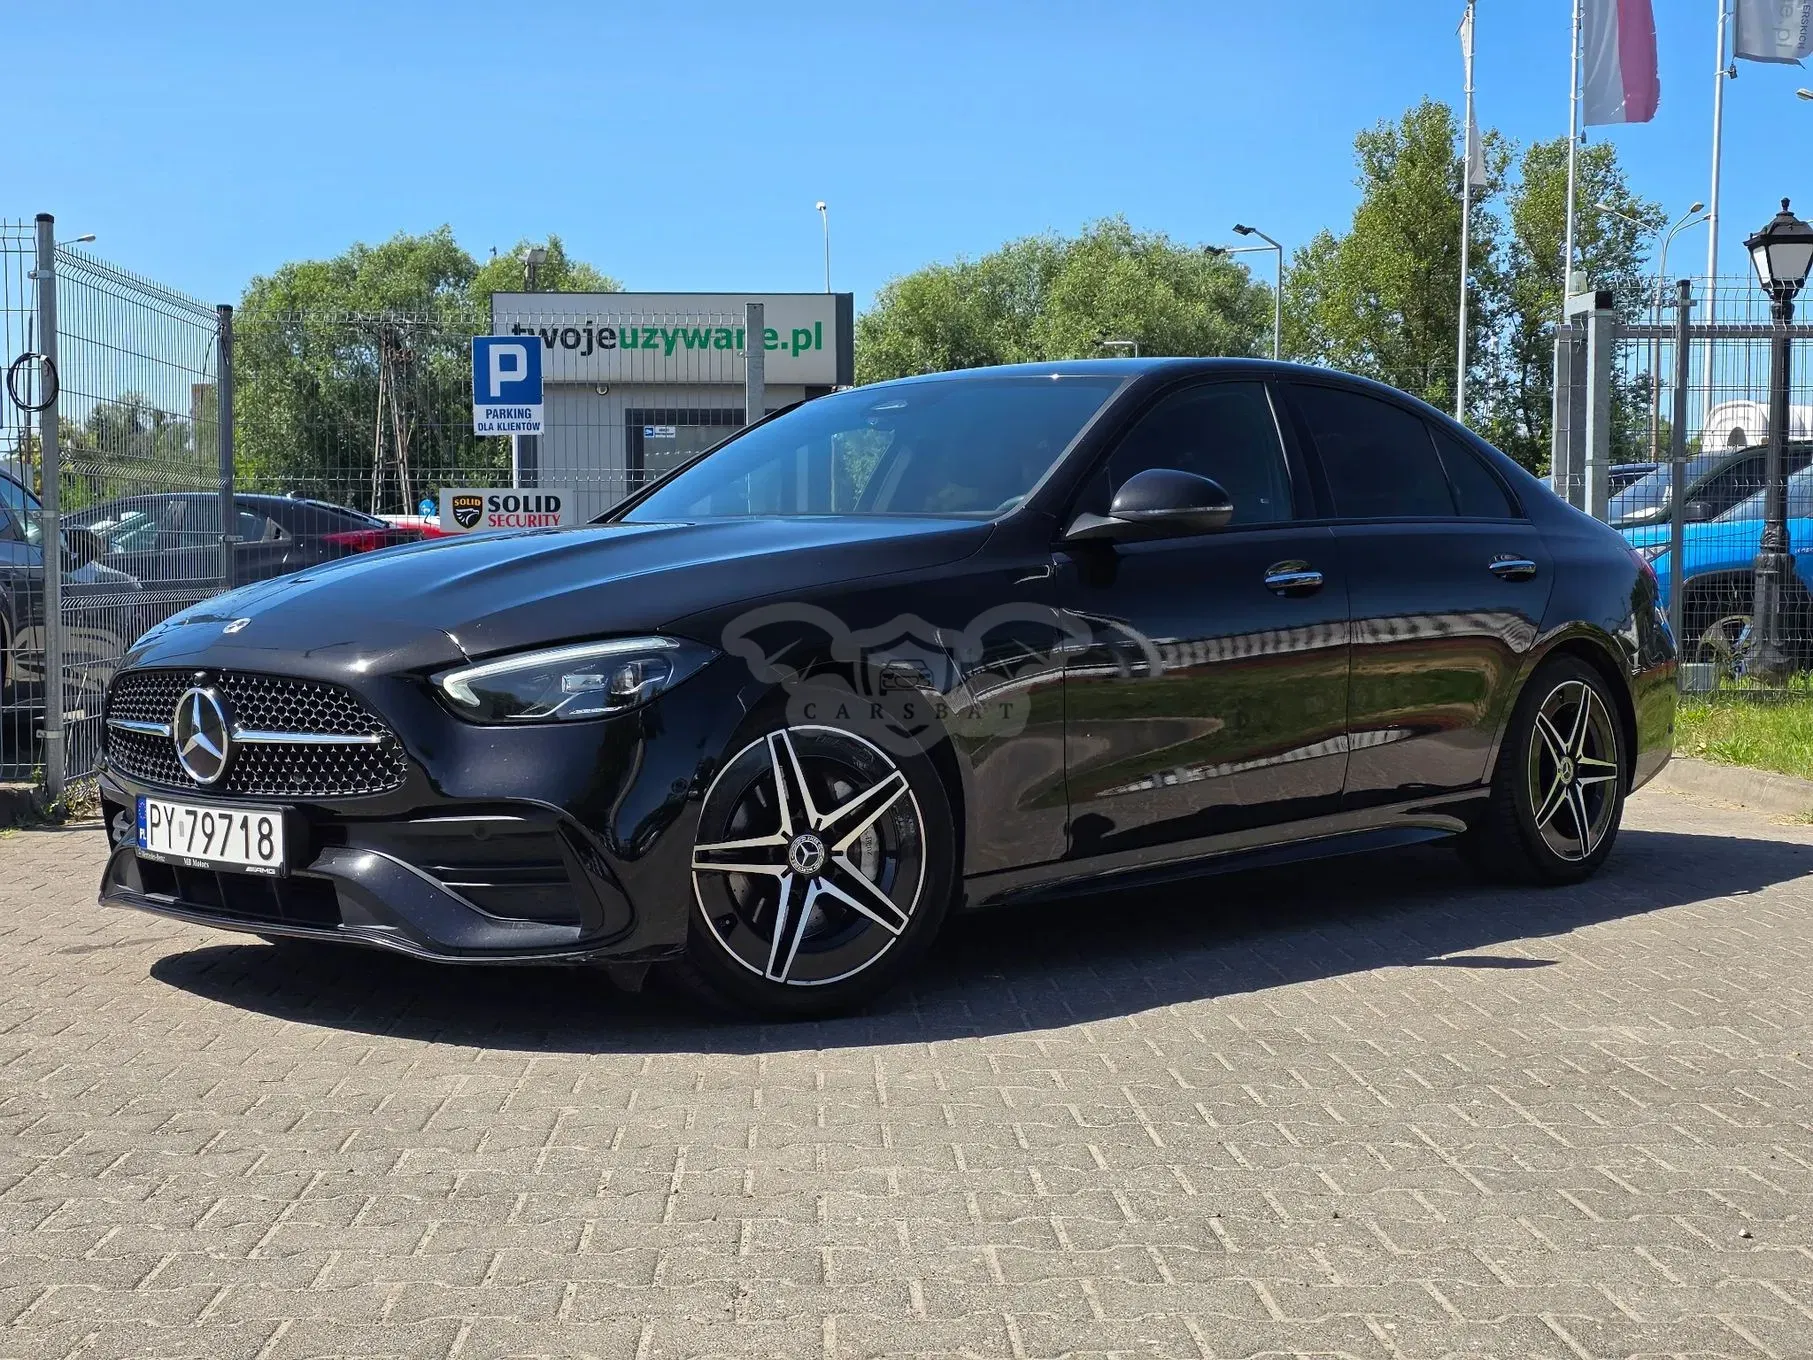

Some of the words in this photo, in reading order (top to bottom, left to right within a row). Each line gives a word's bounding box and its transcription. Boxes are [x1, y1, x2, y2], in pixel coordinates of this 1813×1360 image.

[1797, 0, 1811, 49] ERSKICH
[489, 344, 528, 398] P
[485, 408, 532, 420] PARKING
[477, 422, 494, 432] DLA
[497, 420, 541, 432] KLIENTÓW
[453, 497, 482, 507] SOLID
[487, 495, 562, 513] SOLID
[487, 513, 562, 528] SECURITY
[139, 827, 147, 841] PL
[149, 803, 175, 849] PY
[185, 809, 275, 861] 79718
